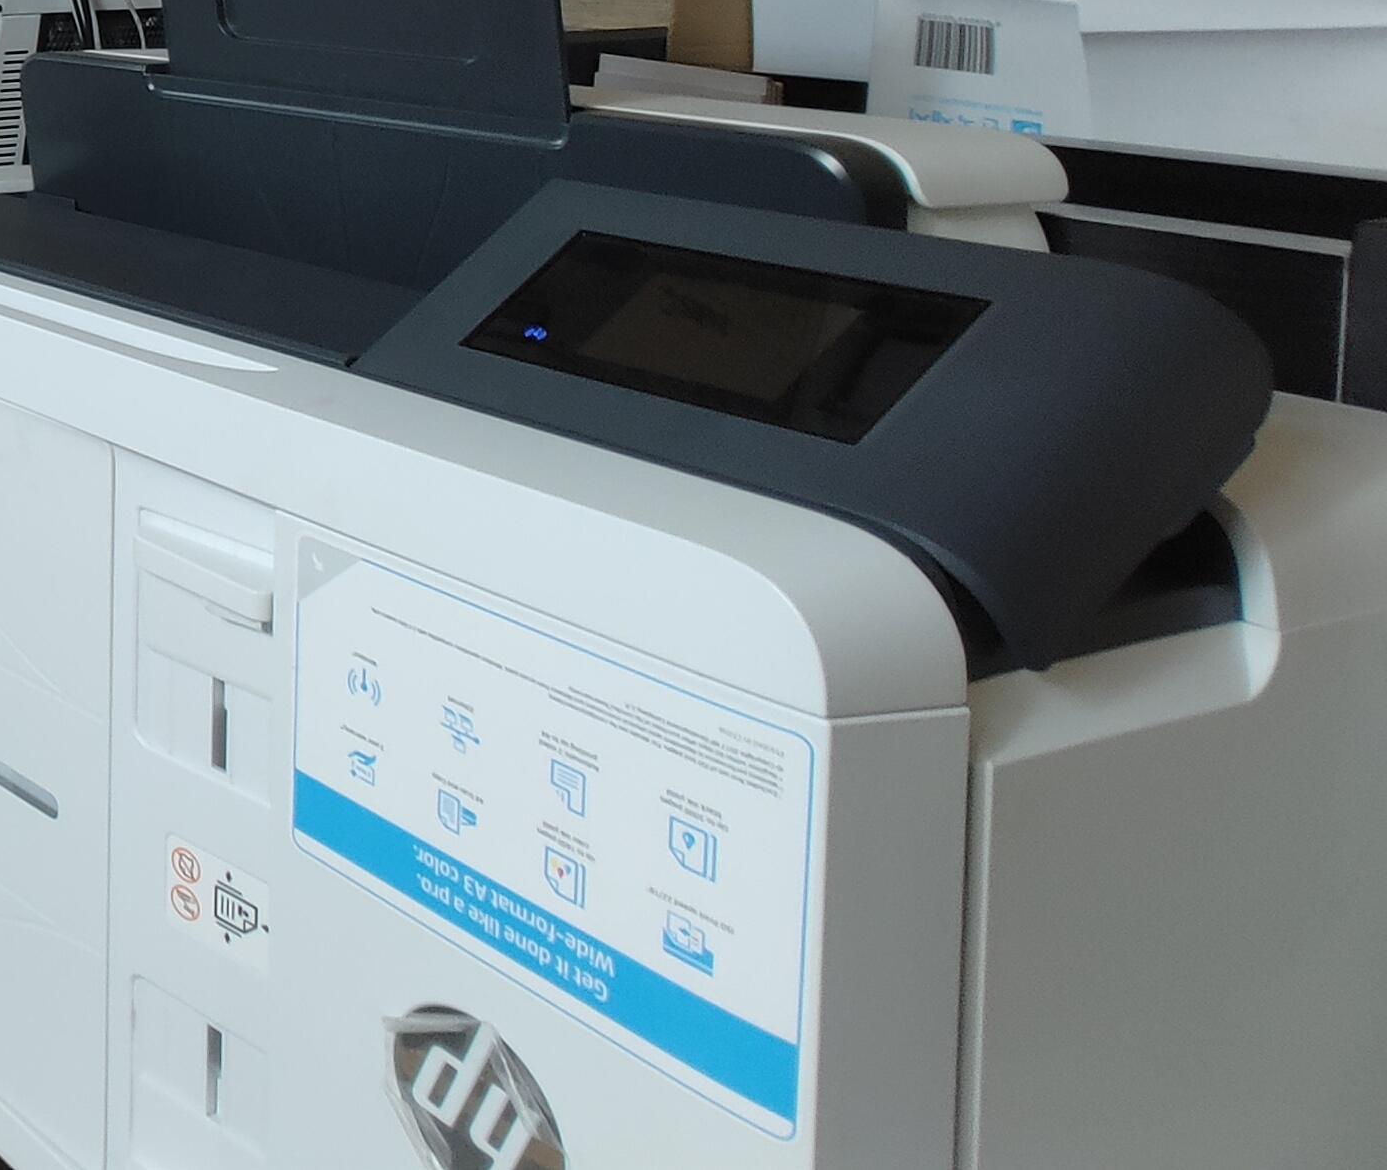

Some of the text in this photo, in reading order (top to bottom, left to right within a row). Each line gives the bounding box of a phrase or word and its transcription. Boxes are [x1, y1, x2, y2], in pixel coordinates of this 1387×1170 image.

[413, 843, 616, 978] Wide-format A3 color.
[417, 872, 609, 1003] Get it done like a pro.
[413, 1020, 534, 1170] hp
